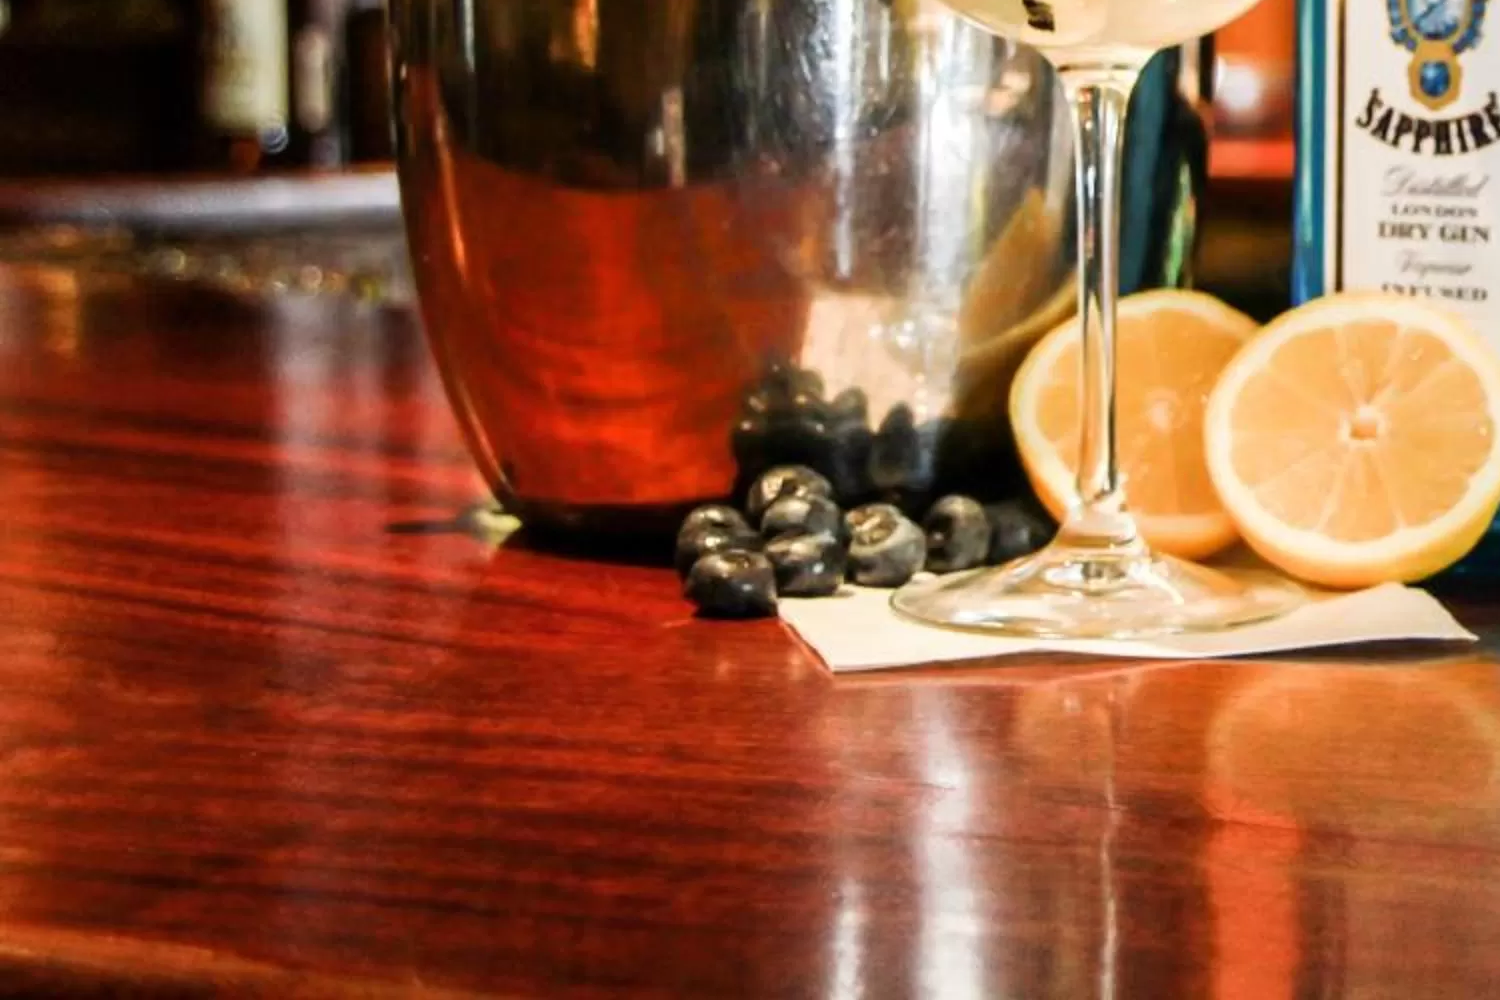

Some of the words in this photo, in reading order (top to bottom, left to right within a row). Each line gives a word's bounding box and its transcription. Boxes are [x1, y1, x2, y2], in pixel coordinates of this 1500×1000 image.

[1391, 203, 1478, 218] LONDON
[1378, 221, 1431, 240] DRY
[1438, 224, 1490, 243] GIN
